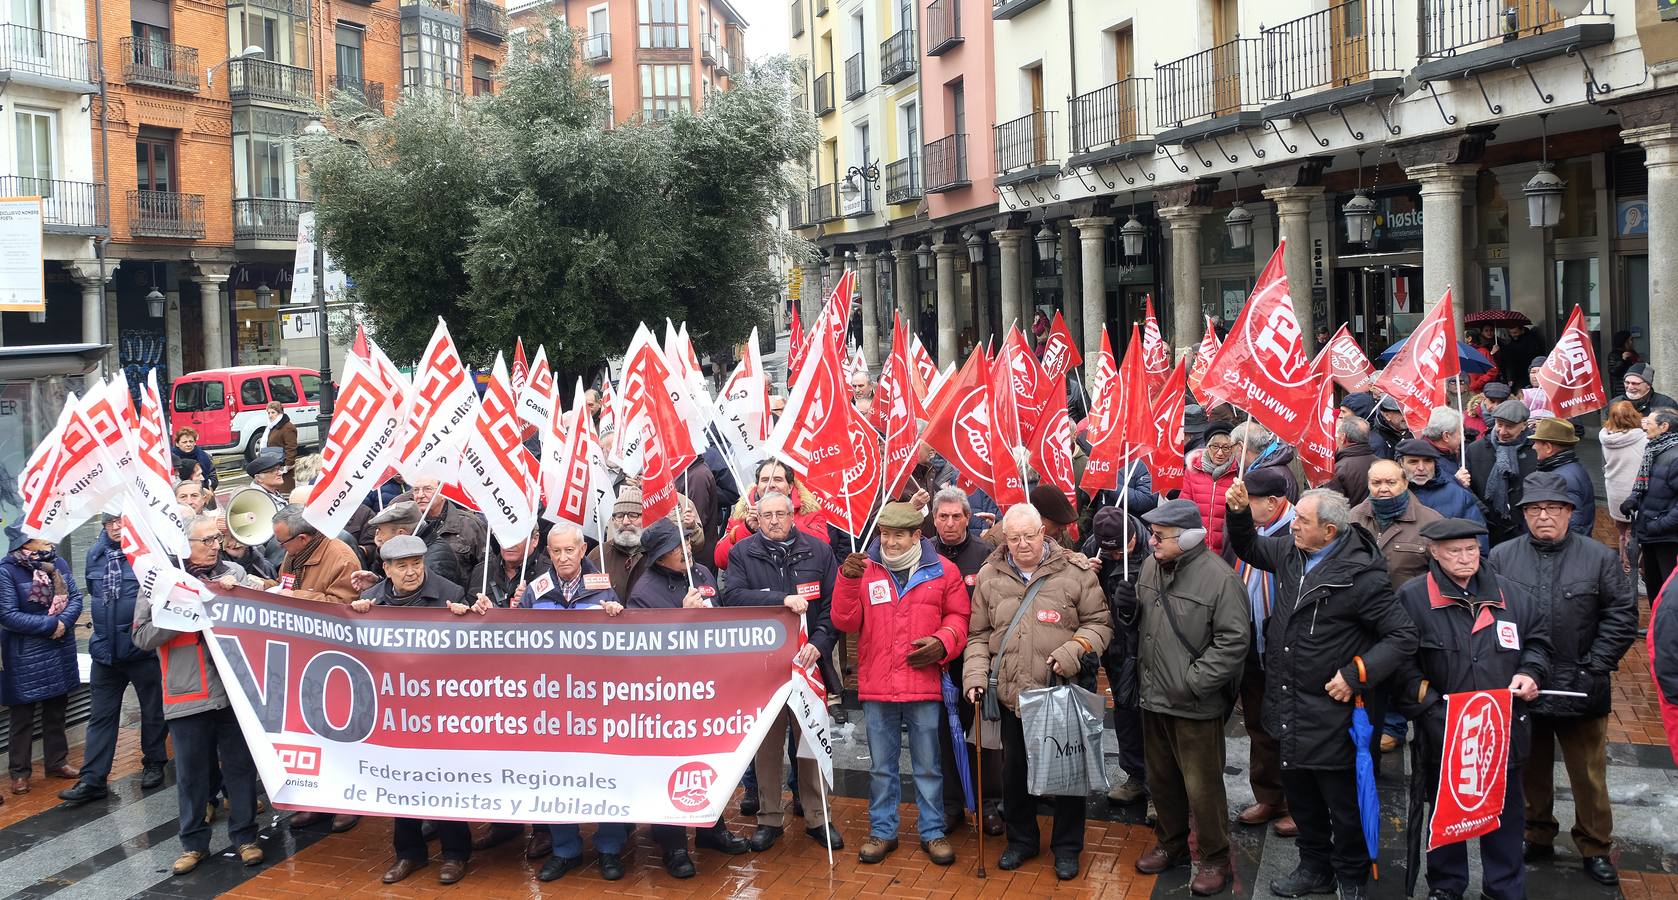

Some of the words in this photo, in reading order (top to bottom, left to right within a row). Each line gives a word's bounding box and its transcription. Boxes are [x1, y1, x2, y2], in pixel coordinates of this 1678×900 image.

[482, 477, 494, 486] y
[492, 488, 520, 524] León
[797, 585, 820, 594] CCOO
[162, 600, 199, 623] León
[210, 602, 229, 622] SI
[233, 605, 256, 625] NO
[259, 609, 354, 643] DEFENDEMOS
[356, 626, 451, 649] NUESTROS
[455, 629, 554, 649] DERECHOS
[559, 629, 597, 650] NOS
[602, 630, 663, 651] DEJAN
[667, 628, 699, 650] SIN
[704, 626, 776, 648] FUTURO
[214, 634, 378, 743] NO
[381, 672, 394, 696] A
[401, 672, 431, 697] los
[436, 674, 528, 698] recortes
[533, 674, 560, 699] de
[566, 673, 597, 699] las
[602, 675, 716, 705] pensiones
[382, 708, 396, 731] A
[402, 708, 432, 733] los
[437, 710, 528, 734] recortes
[533, 710, 560, 736] de
[566, 709, 597, 736] las
[602, 712, 698, 742] políticas
[1457, 713, 1483, 796] UGT
[358, 760, 492, 783] Federaciones
[501, 768, 617, 790] Regionales
[674, 768, 713, 793] UGT
[343, 784, 368, 801] de
[376, 786, 502, 811] Pensionistas
[510, 799, 523, 815] y
[528, 795, 630, 817] Jubilados
